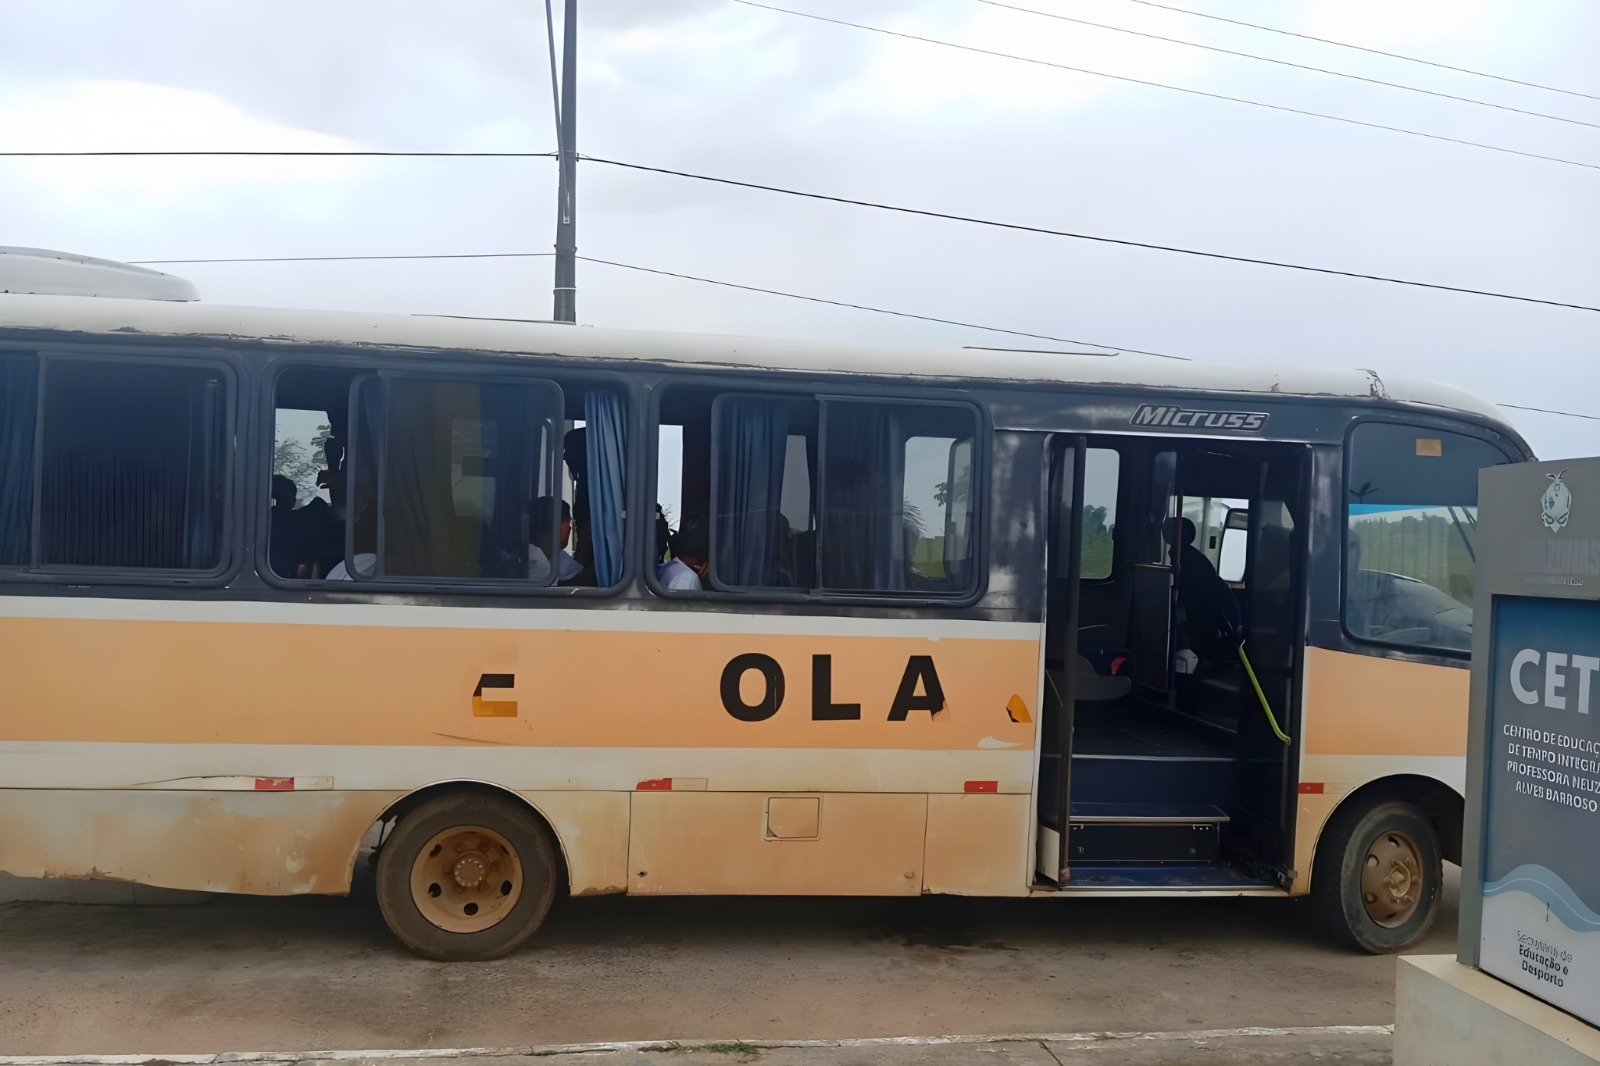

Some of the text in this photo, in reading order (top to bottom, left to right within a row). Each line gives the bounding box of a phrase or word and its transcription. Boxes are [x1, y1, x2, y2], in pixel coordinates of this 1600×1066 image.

[1503, 724, 1541, 742] CENTRO
[1543, 732, 1556, 745] DE
[1508, 743, 1520, 756] DE
[1522, 745, 1556, 764] TEMPO
[1507, 760, 1570, 787] PROFESSORA
[1515, 780, 1598, 813] ALVES BARROSO
[1519, 944, 1561, 971] Educação
[1522, 959, 1564, 987] Desporto
